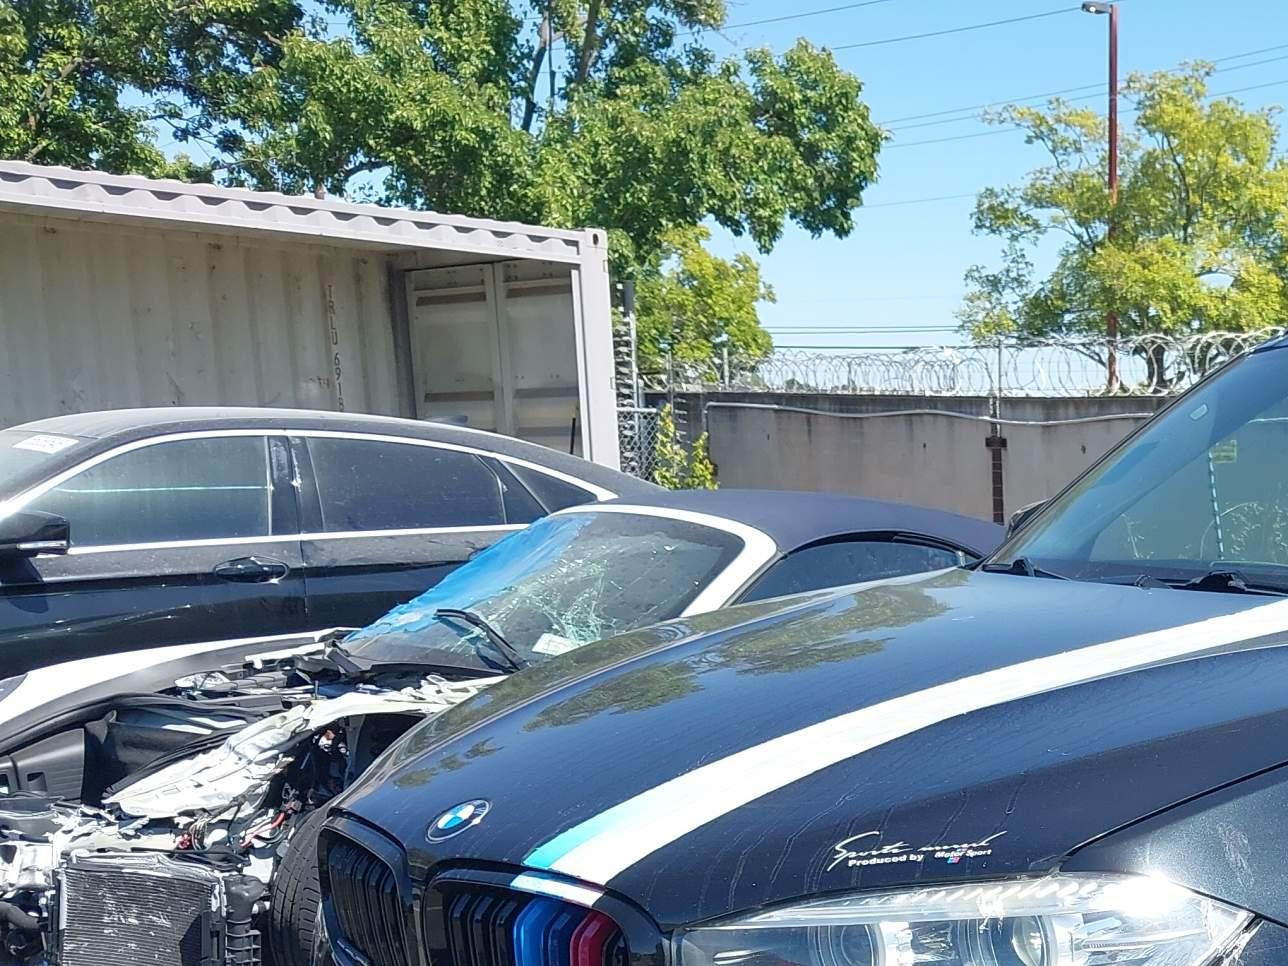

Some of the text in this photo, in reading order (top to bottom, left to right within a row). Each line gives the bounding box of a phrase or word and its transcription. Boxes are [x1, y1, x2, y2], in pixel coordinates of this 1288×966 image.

[327, 284, 339, 346] TRLU
[848, 854, 907, 867] Produced
[909, 853, 925, 862] by
